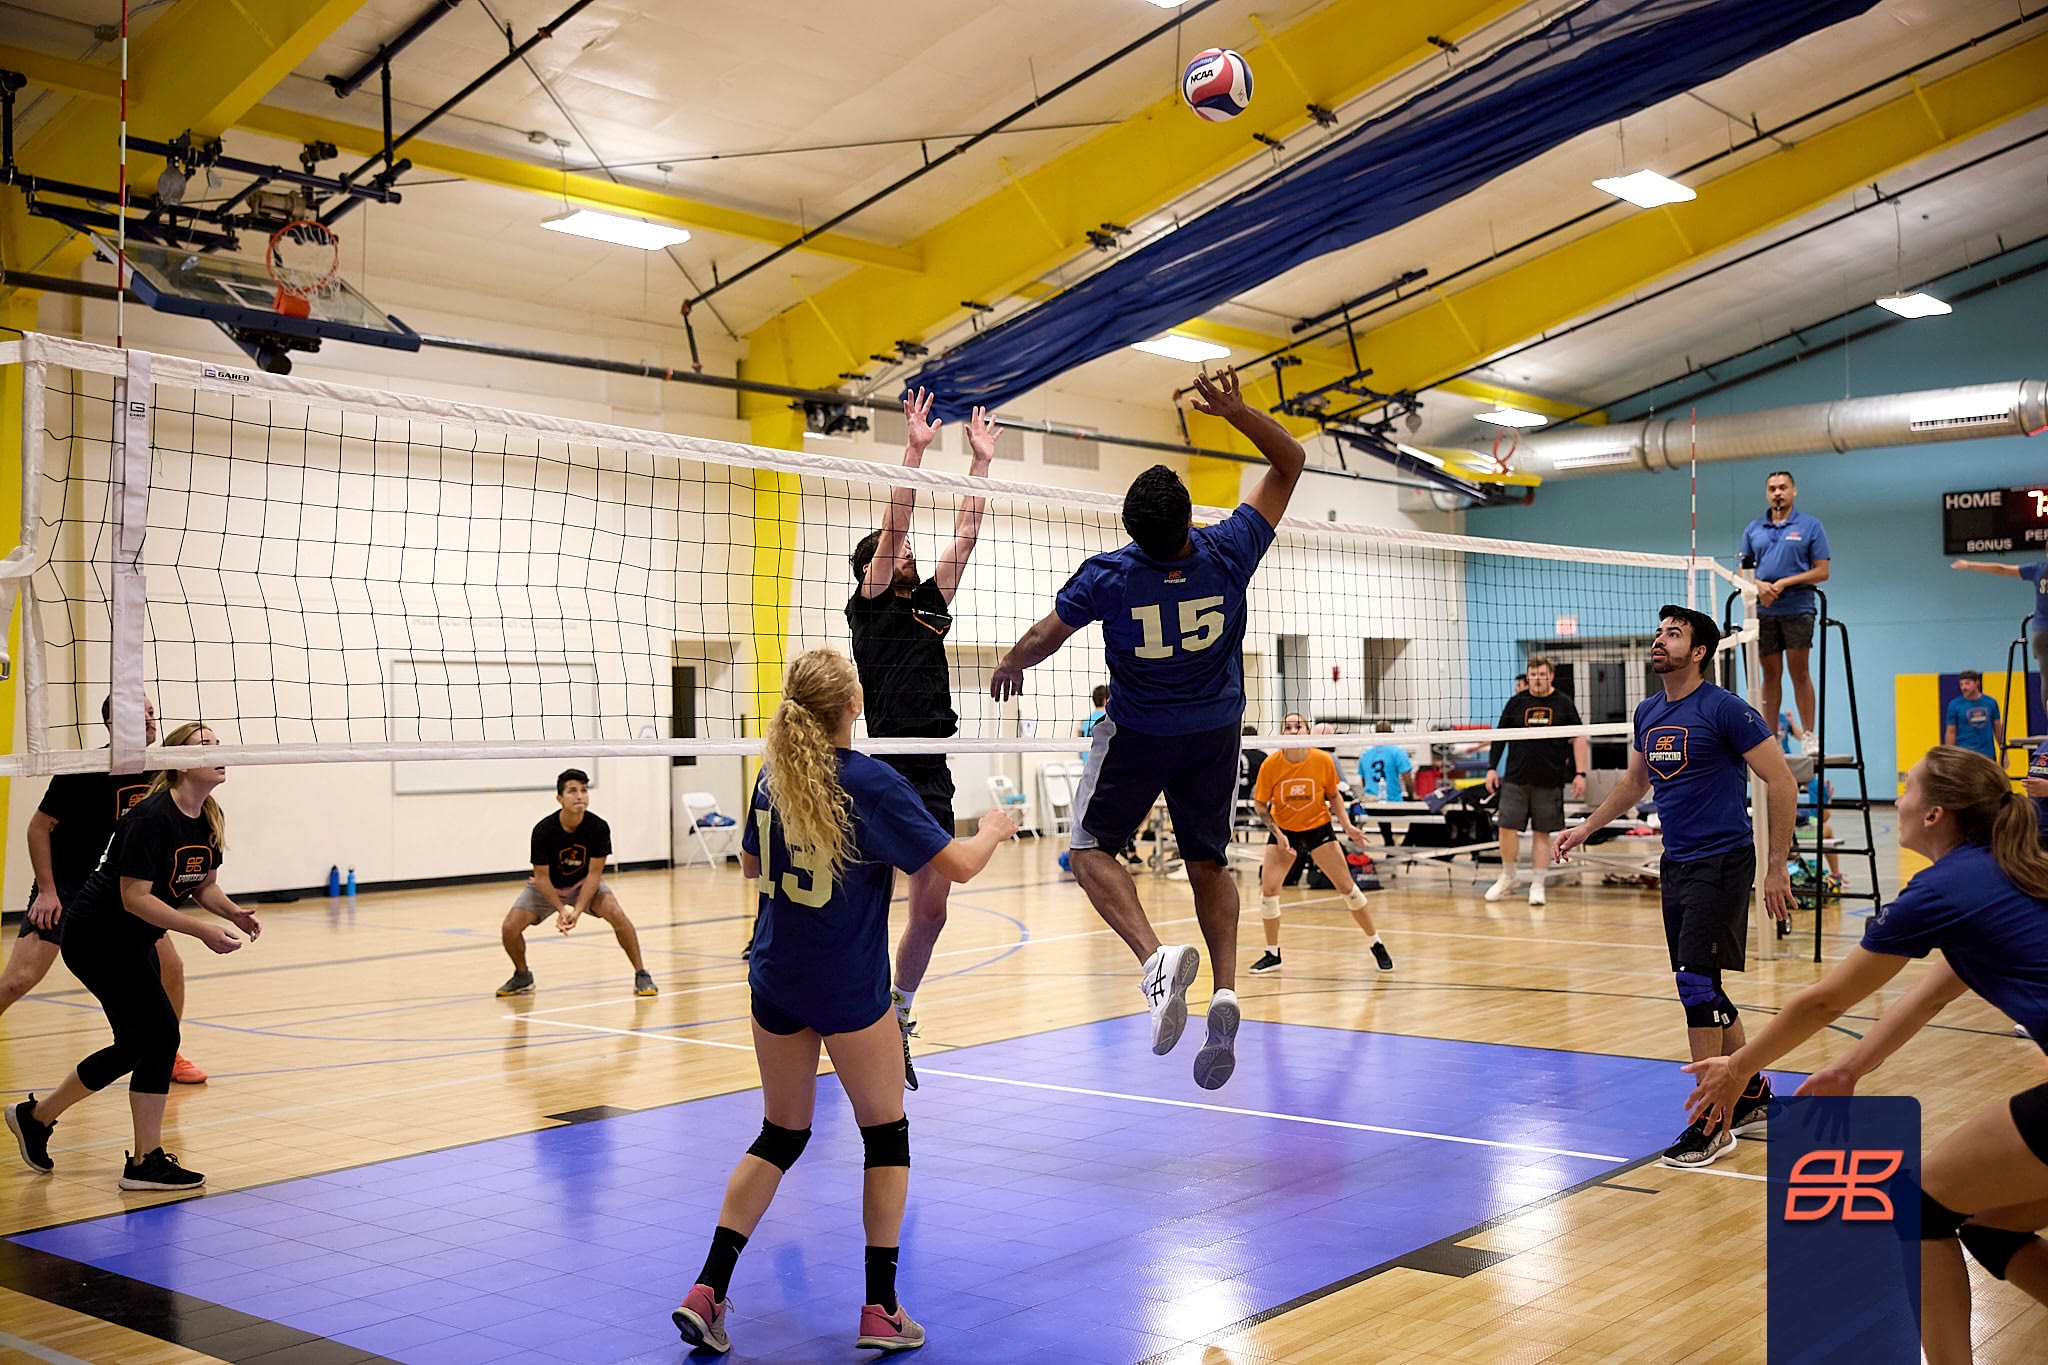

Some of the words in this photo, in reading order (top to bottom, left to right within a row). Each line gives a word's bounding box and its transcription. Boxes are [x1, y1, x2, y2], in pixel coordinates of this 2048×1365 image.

[1190, 69, 1214, 84] NCAA
[218, 371, 249, 381] GARED
[1945, 490, 2002, 510] HOME
[1966, 538, 2013, 553] BONUS
[1131, 595, 1225, 659] 15
[1649, 751, 1682, 762] SPORTSKIND
[1371, 760, 1386, 783] 3
